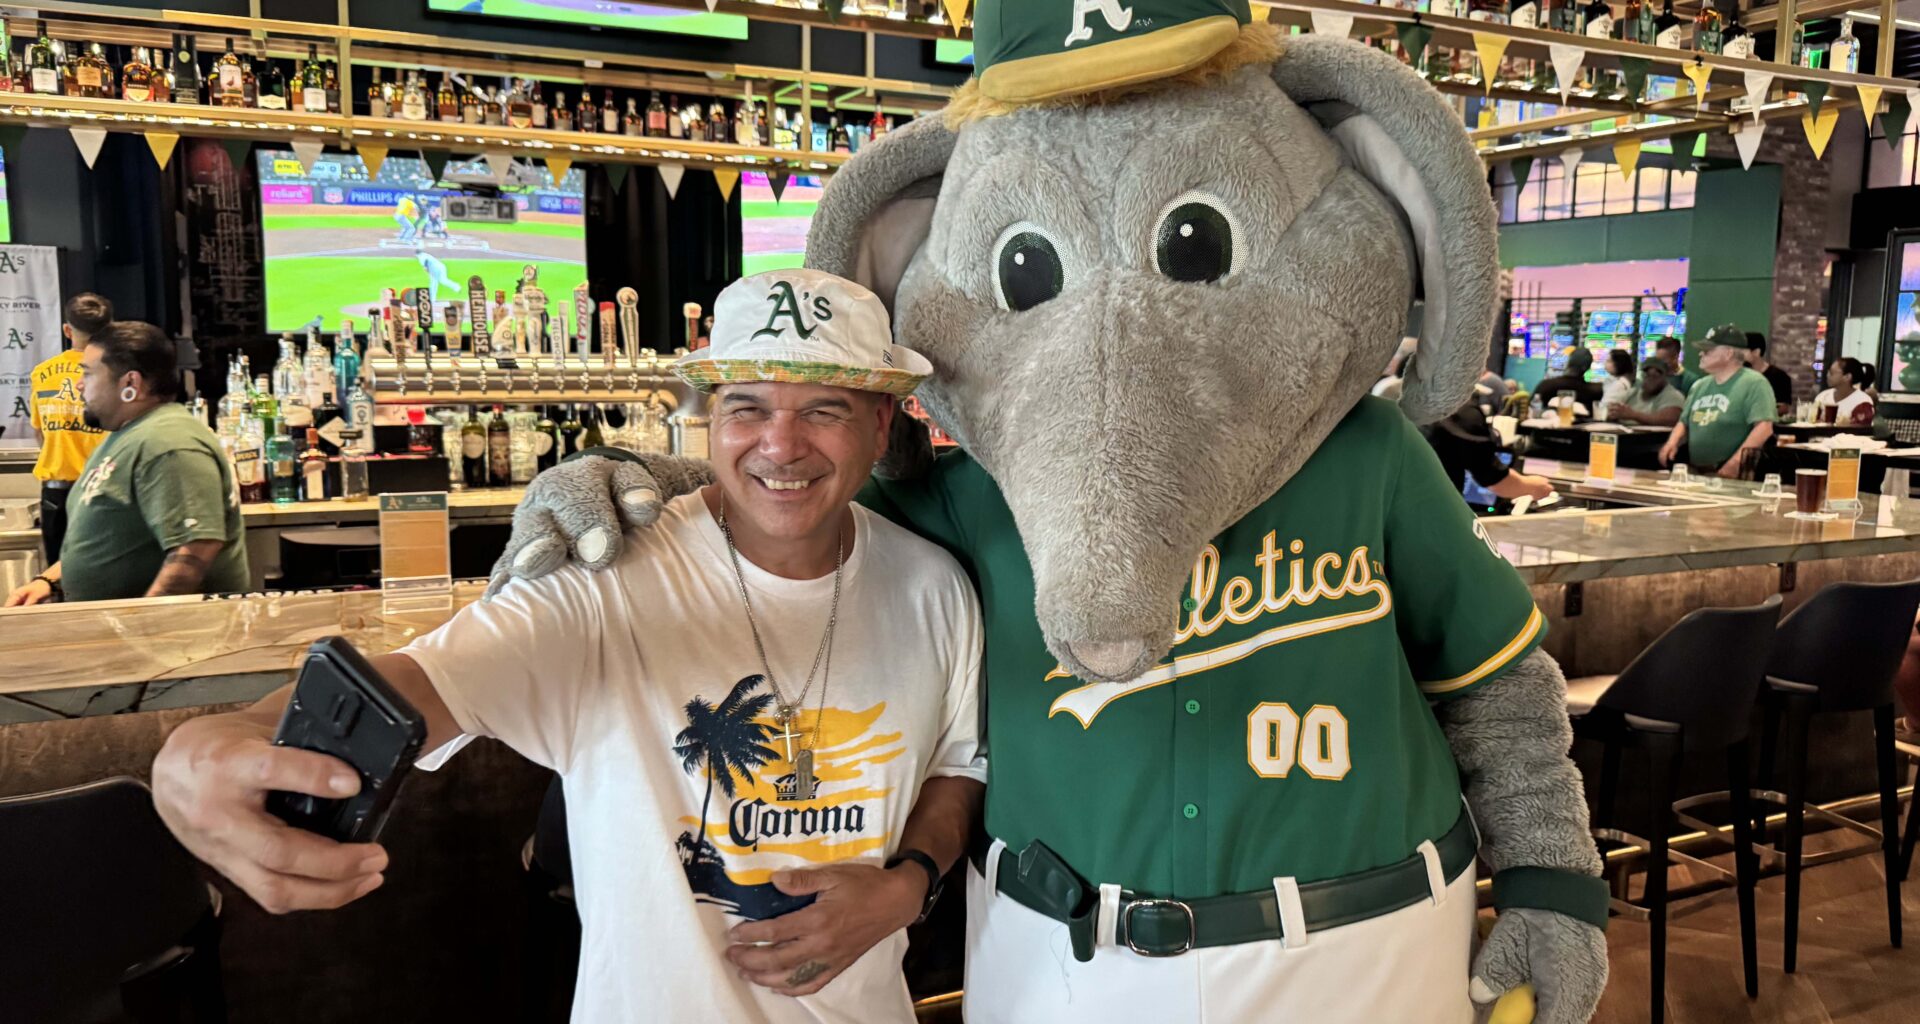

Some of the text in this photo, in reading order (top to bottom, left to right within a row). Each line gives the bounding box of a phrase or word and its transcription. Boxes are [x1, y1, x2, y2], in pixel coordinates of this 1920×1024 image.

[351, 191, 393, 203] PHILLIPS
[3, 328, 35, 349] A's
[470, 290, 489, 355] HENHOUSE
[750, 281, 833, 342] A's
[1175, 529, 1373, 645] letics
[1246, 701, 1352, 781] 00
[728, 797, 865, 852] Corona
